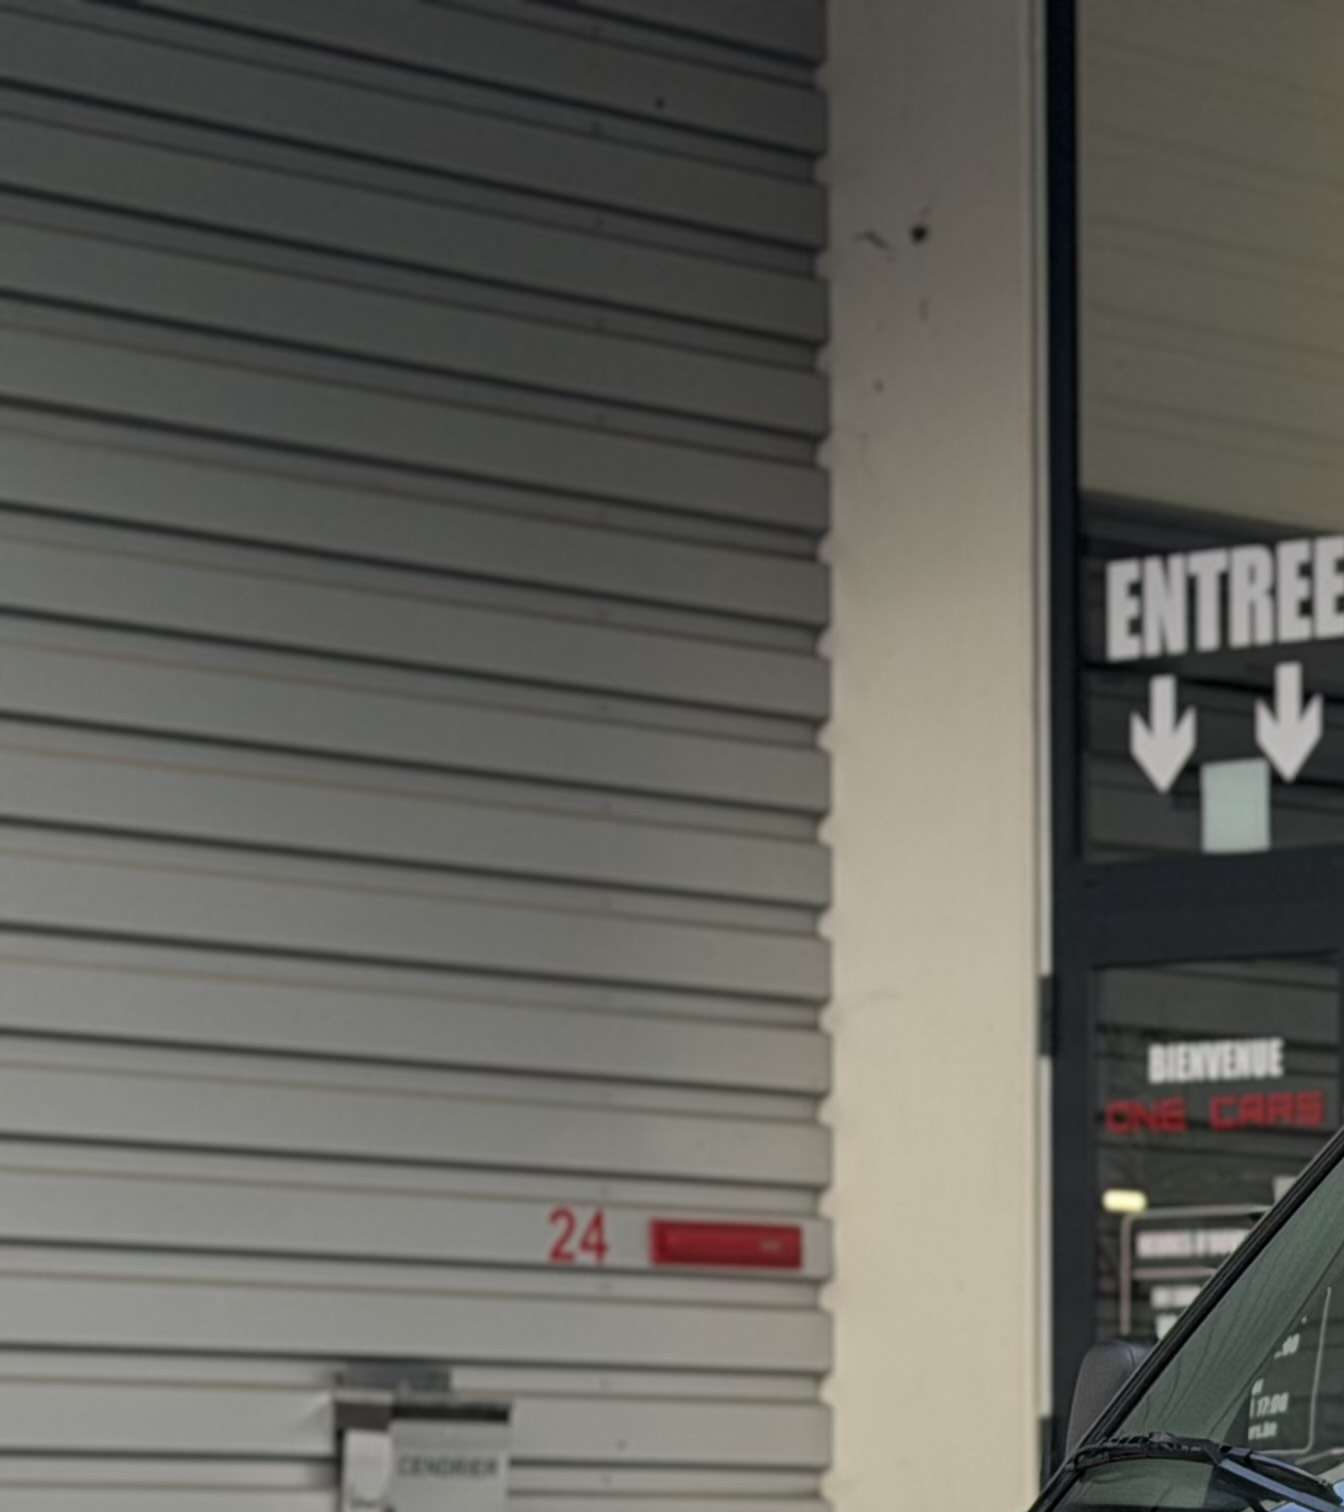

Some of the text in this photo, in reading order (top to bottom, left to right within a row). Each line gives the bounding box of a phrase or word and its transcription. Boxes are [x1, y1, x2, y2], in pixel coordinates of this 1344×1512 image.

[1148, 1038, 1285, 1084] BIENVENUE
[1105, 1090, 1324, 1134] ONE CARS
[548, 1206, 609, 1264] 24
